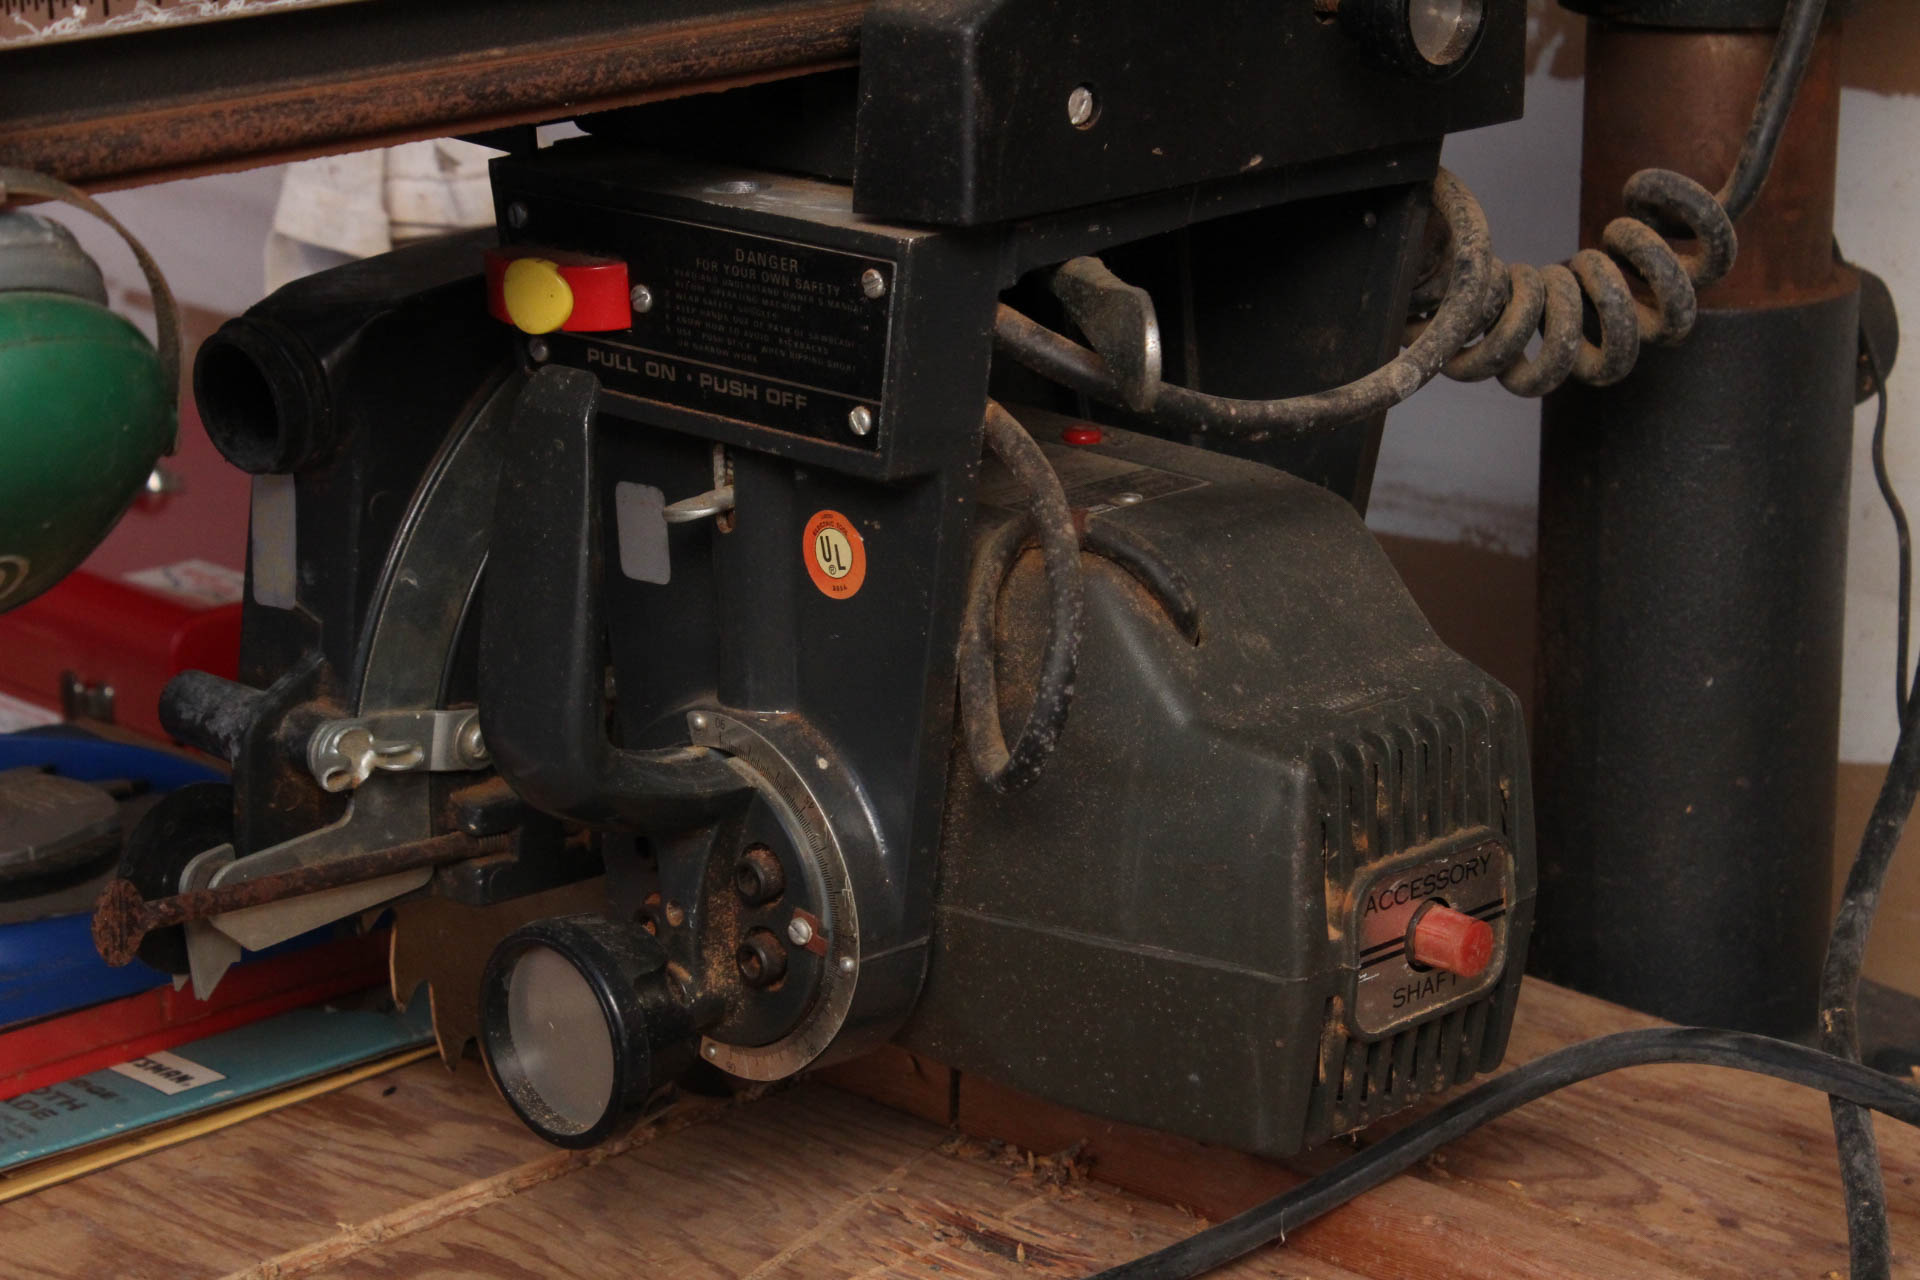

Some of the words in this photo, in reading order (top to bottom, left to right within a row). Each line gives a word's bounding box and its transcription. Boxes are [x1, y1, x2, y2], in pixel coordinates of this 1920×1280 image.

[696, 257, 717, 272] FOR
[723, 263, 756, 280] YOUR
[761, 271, 789, 286] OWN
[795, 277, 840, 297] SAFETY
[735, 247, 799, 273] DANGER
[587, 347, 639, 375] PULL
[644, 360, 676, 382] ON
[699, 372, 758, 401] PUSH
[765, 390, 808, 411] OFF
[819, 535, 847, 571] UL
[1363, 853, 1493, 918] ACCESSORY
